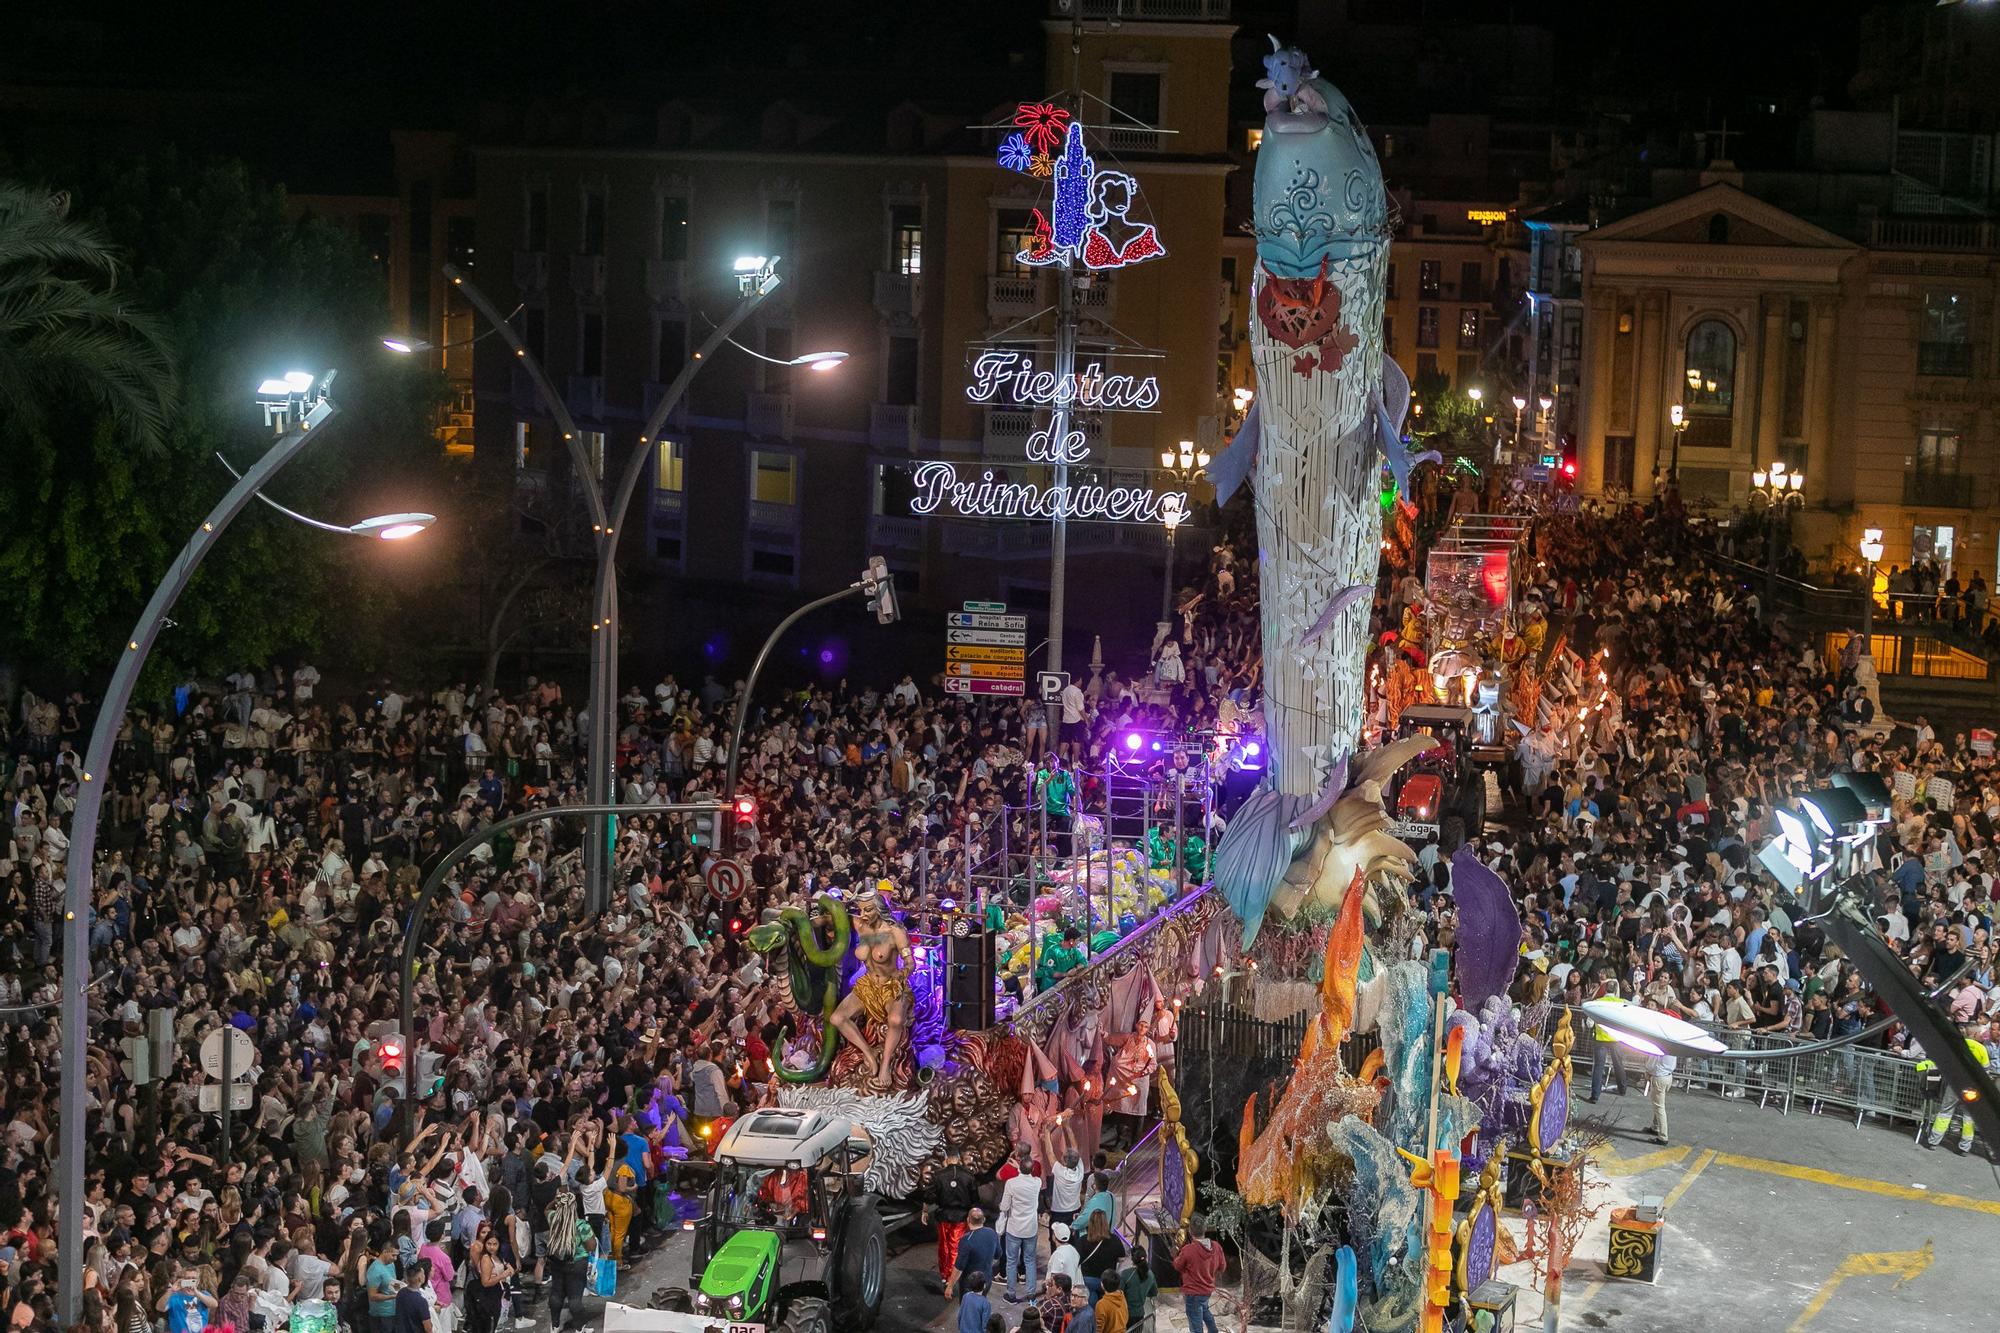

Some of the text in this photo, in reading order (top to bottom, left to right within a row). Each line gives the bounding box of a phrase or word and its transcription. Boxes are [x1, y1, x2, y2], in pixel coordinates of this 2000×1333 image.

[1468, 210, 1507, 221] PENSION
[966, 352, 1161, 409] Fiestas
[1026, 411, 1091, 463] de
[910, 461, 1192, 523] Primavera
[1042, 675, 1062, 701] P
